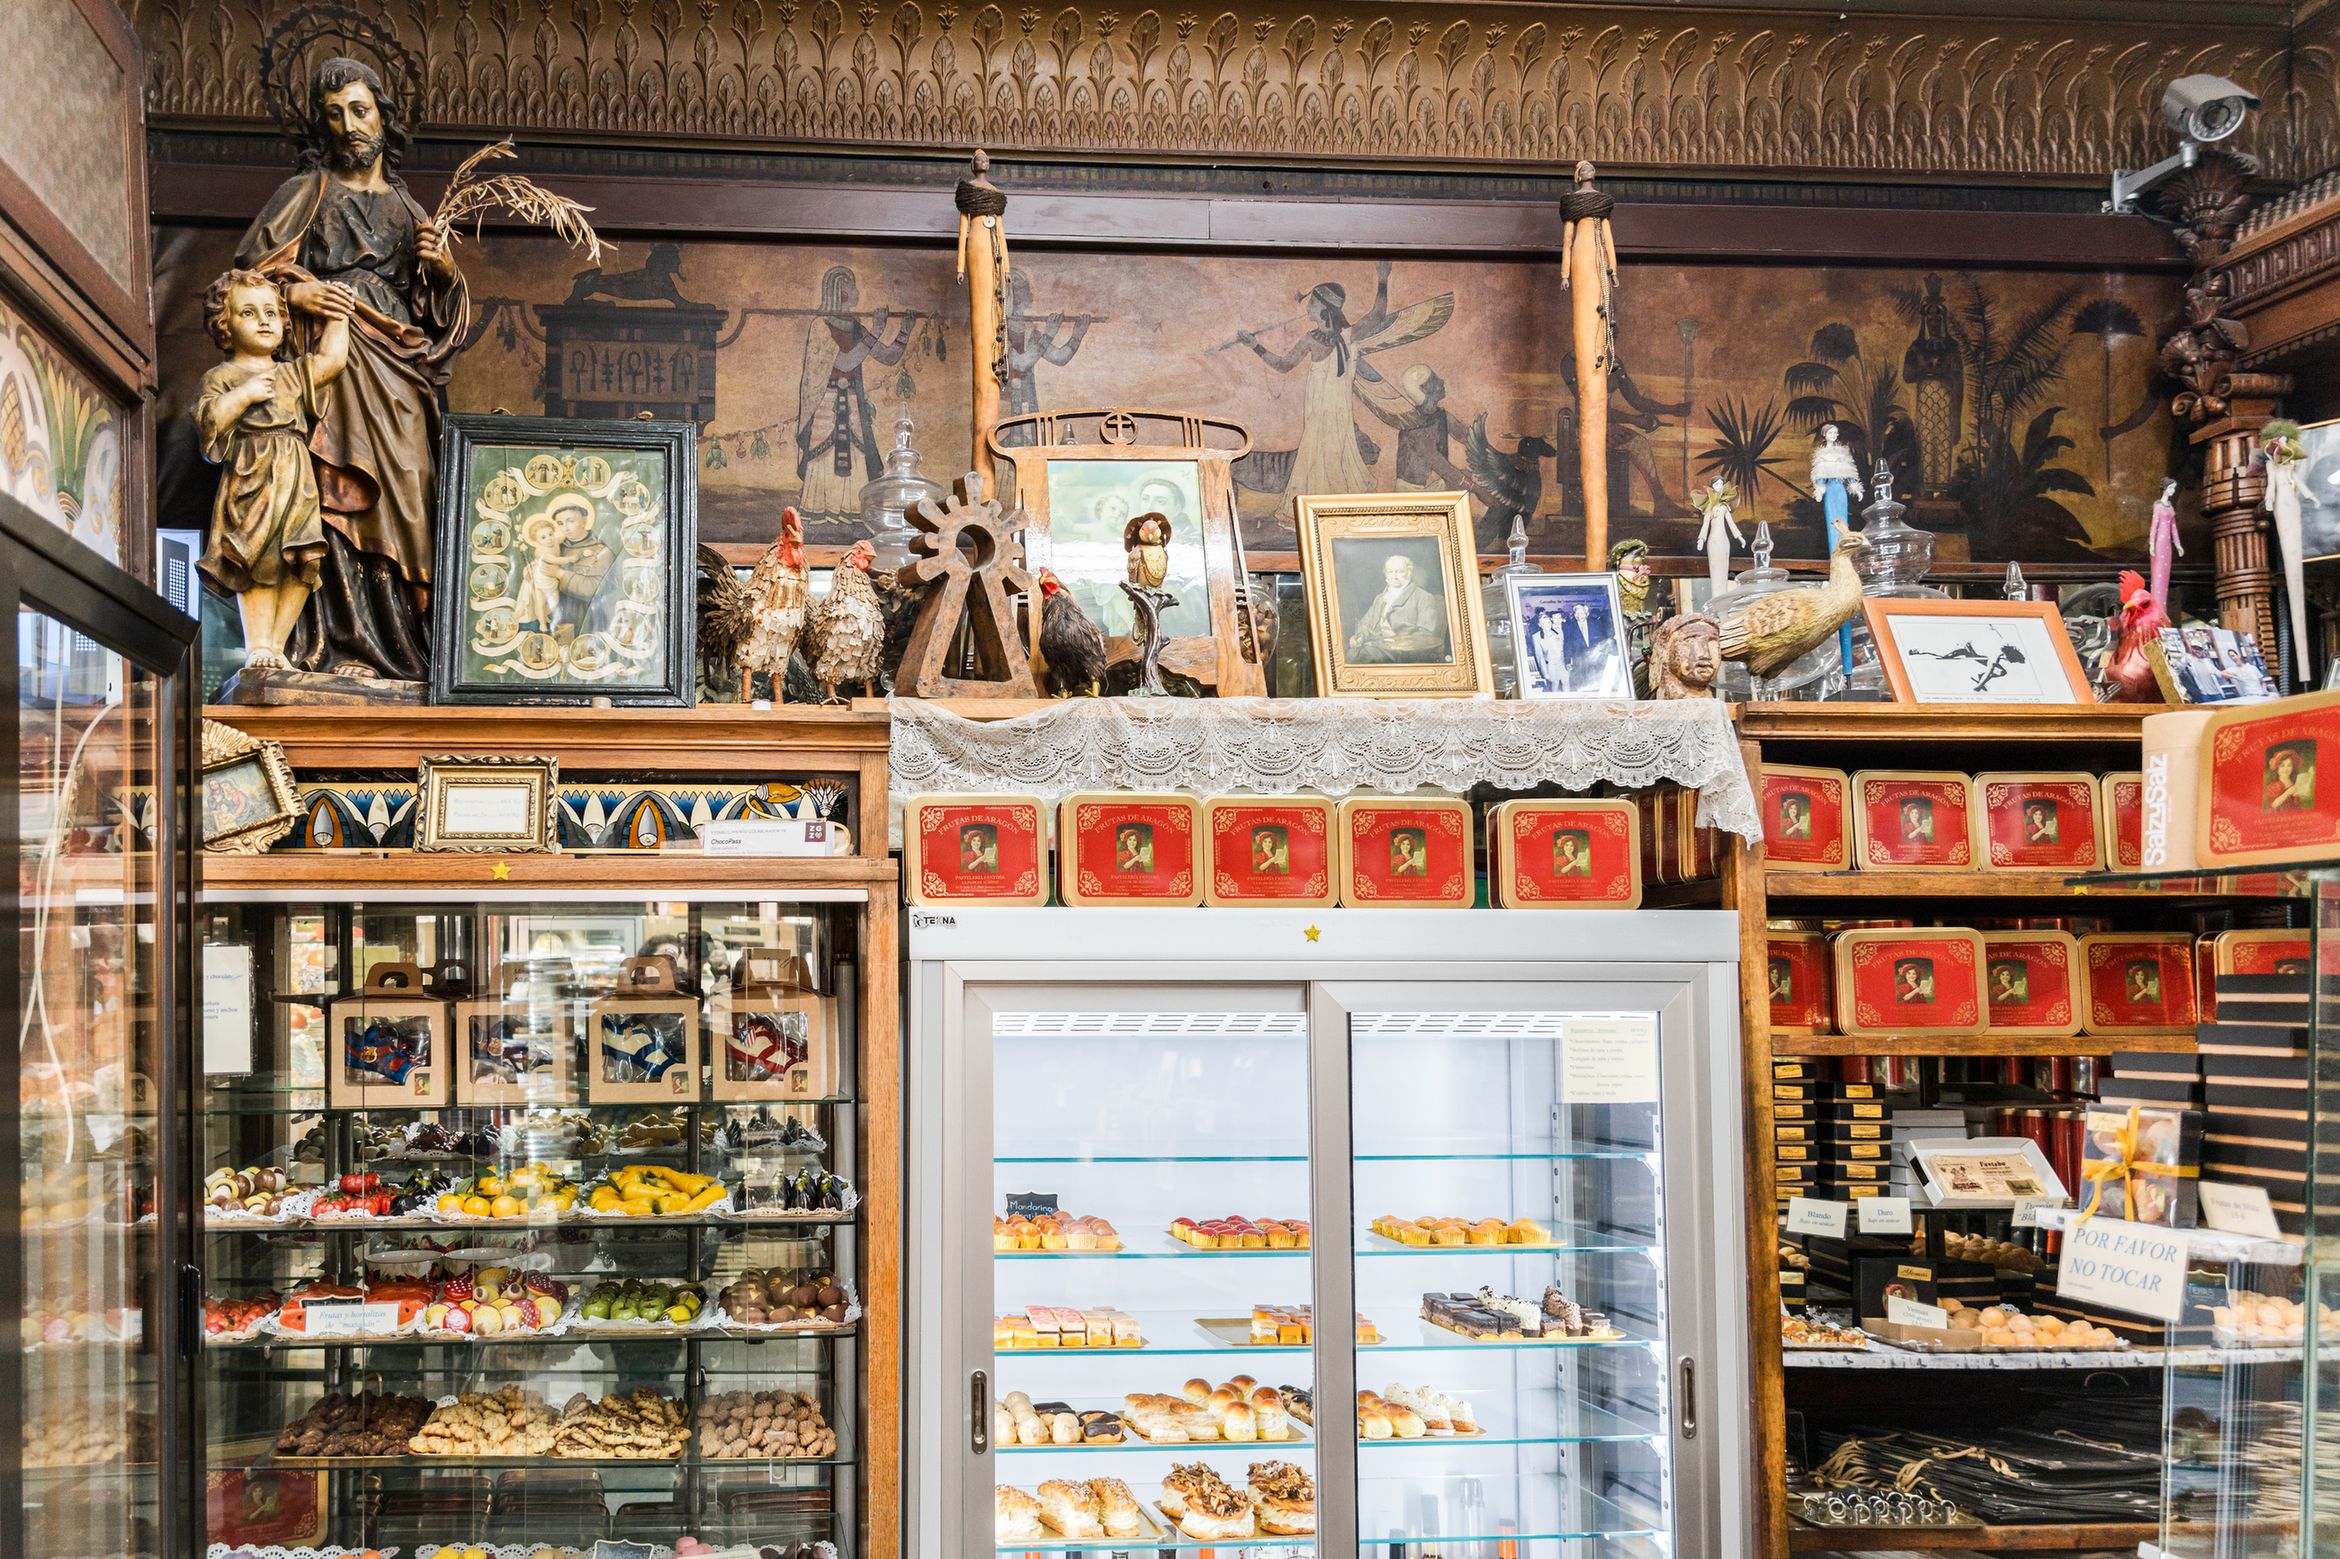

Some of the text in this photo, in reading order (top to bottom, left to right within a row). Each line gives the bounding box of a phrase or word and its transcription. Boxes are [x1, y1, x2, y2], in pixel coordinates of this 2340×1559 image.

[2236, 731, 2280, 764] FRUTAS
[2281, 727, 2298, 737] DE
[1881, 790, 1908, 807] FRUTAS
[2003, 791, 2032, 809] FRUTAS
[938, 815, 970, 836] FRUTAS
[1094, 815, 1127, 833] FRUTAS
[1231, 817, 1262, 836] FRUTAS
[1369, 819, 1400, 838] FRUTAS
[1532, 820, 1563, 840] FRUTAS
[1872, 951, 1905, 968] FRUTAS
[2000, 951, 2012, 959] DE
[1010, 1200, 1053, 1213] Mandarina
[1807, 1210, 1832, 1220] Blando
[2073, 1227, 2177, 1263] POR FAVOR
[2069, 1258, 2162, 1292] NO TOCAR
[320, 1311, 342, 1319] Frutas
